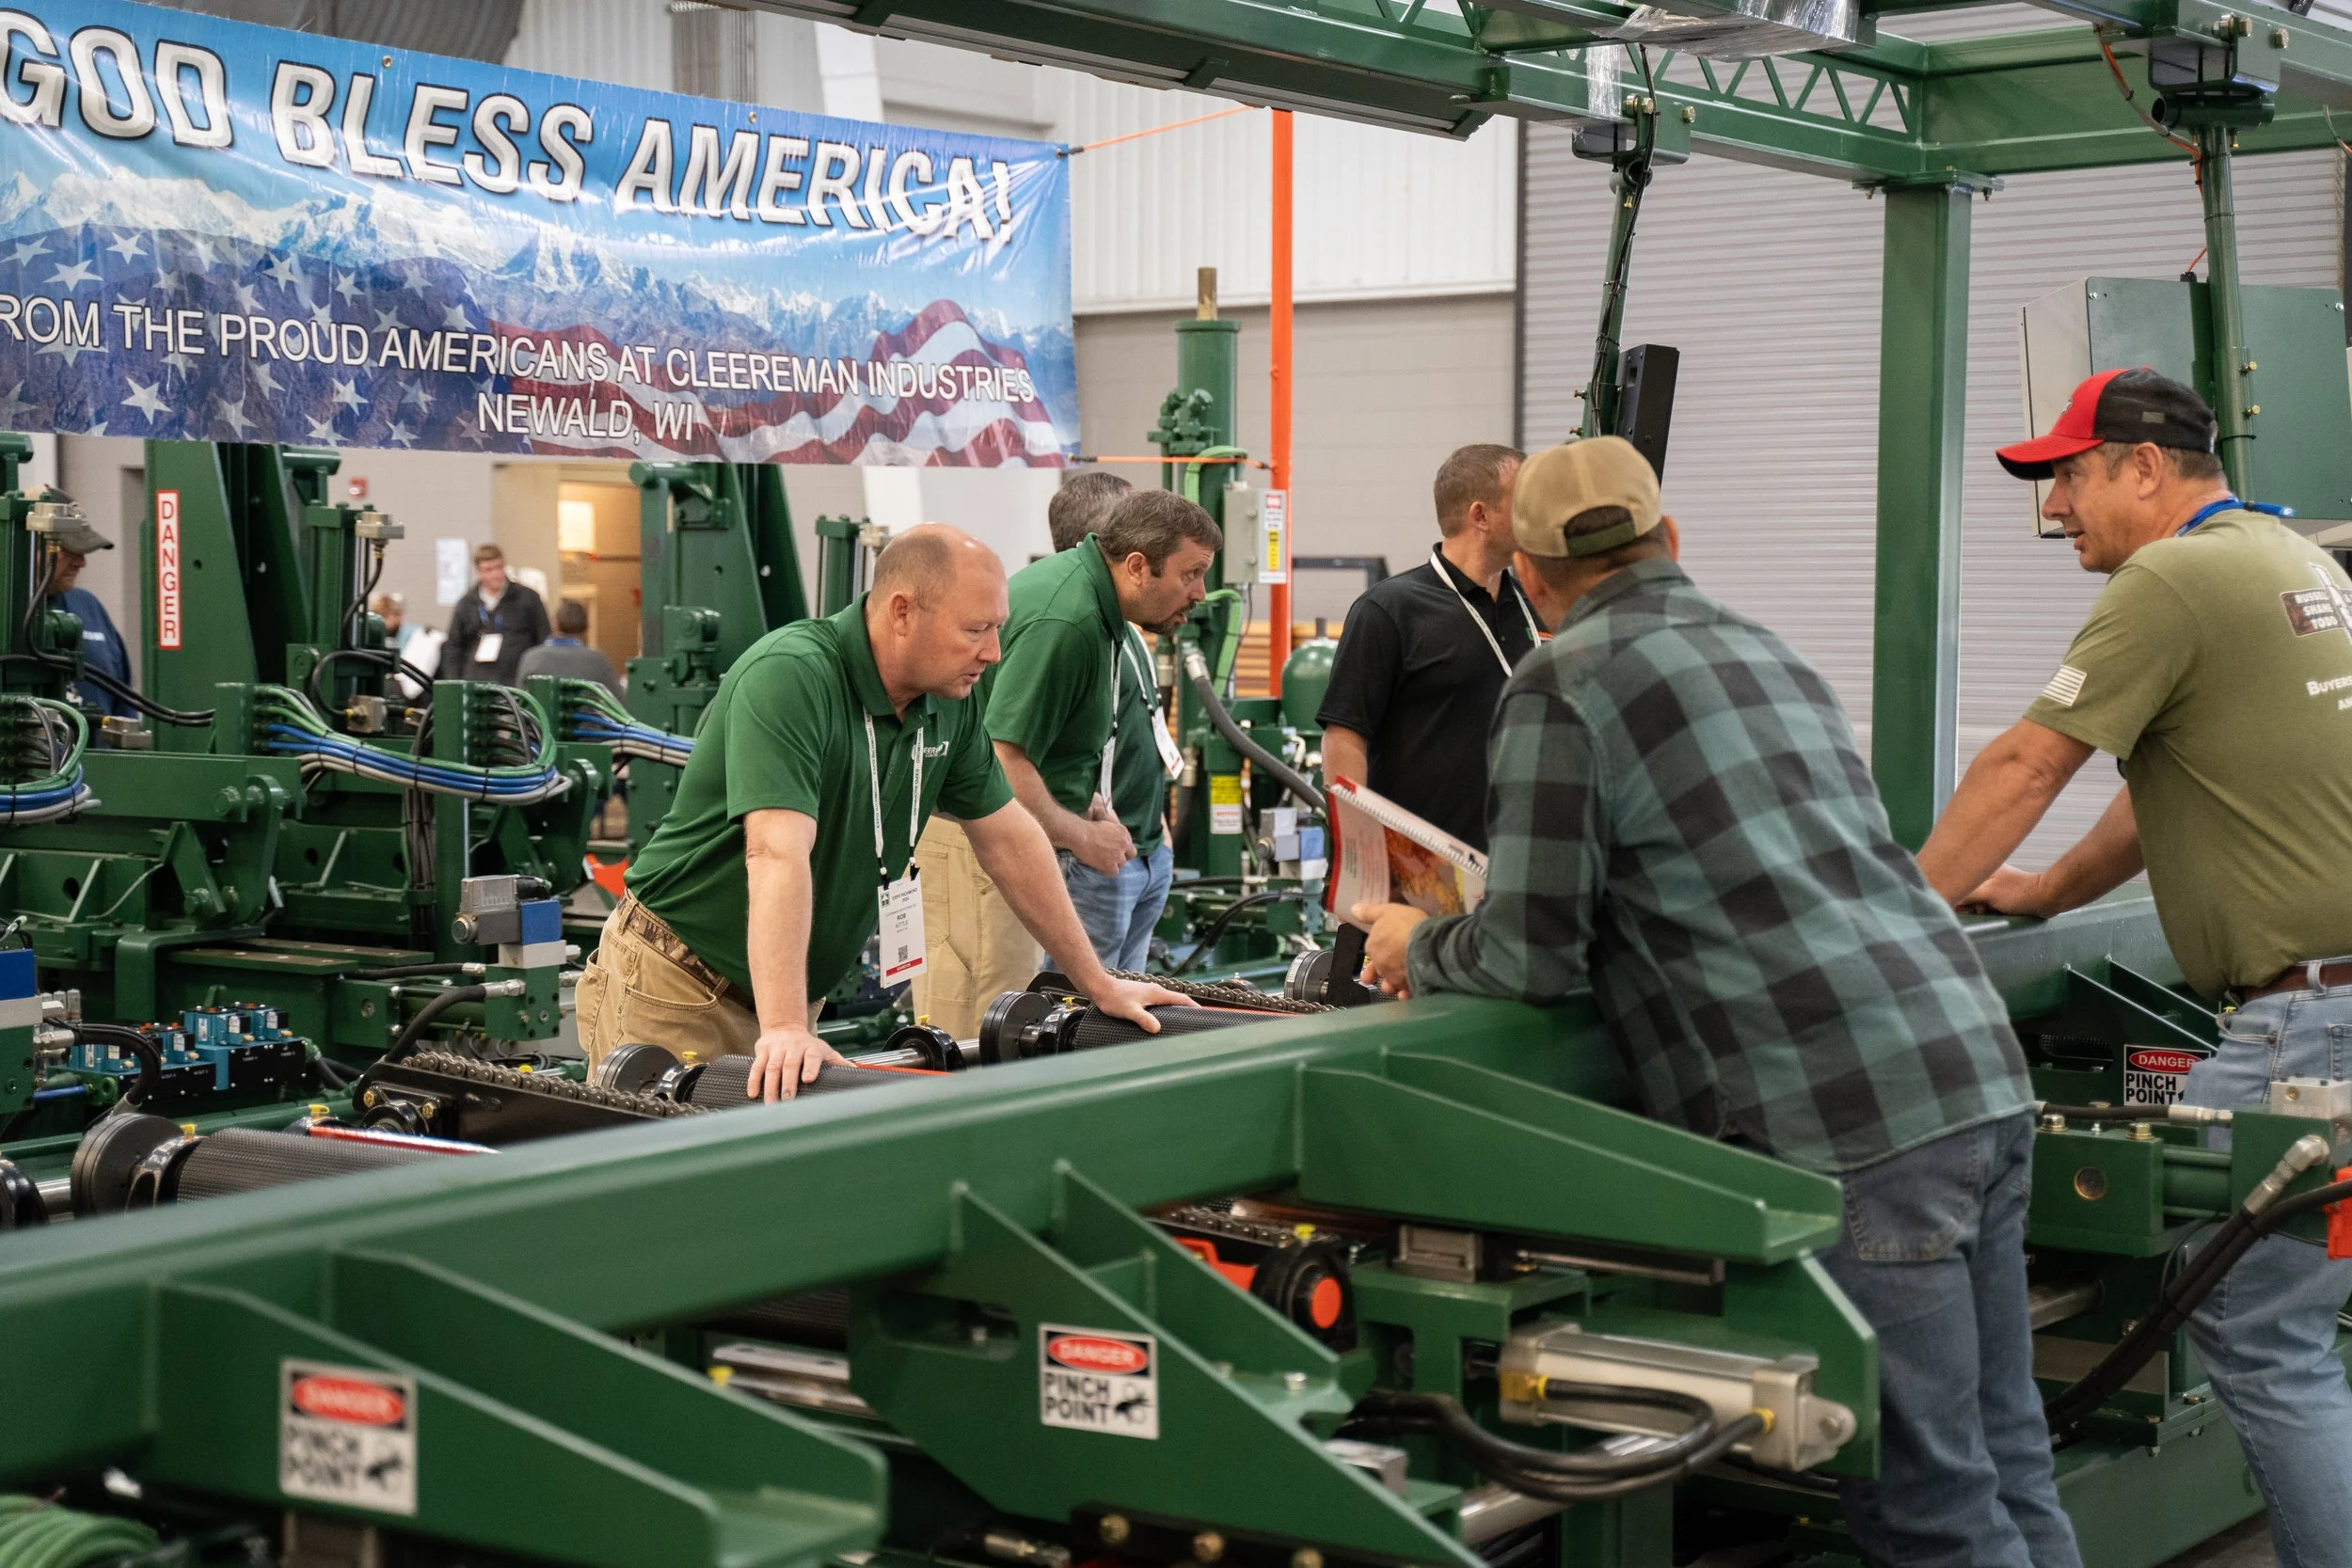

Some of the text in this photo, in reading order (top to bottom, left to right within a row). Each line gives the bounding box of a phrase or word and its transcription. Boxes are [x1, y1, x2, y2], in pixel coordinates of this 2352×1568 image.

[0, 8, 1013, 244] GOD BLESS AMERICA!
[112, 303, 206, 355] THE
[219, 312, 370, 366] PROUD
[377, 326, 611, 382] AMERICANS
[616, 344, 657, 385] AT
[665, 347, 861, 396] CLEEREMAN
[867, 361, 1036, 404] INDUSTRIES
[478, 391, 693, 446] NEWALD, WI
[161, 500, 177, 640] DANGER
[2126, 1072, 2176, 1090] PINCH
[2126, 1087, 2176, 1105] POINT
[1059, 1341, 1135, 1366] DANGER
[1045, 1372, 1109, 1400] PINCH
[1045, 1396, 1110, 1423] POINT
